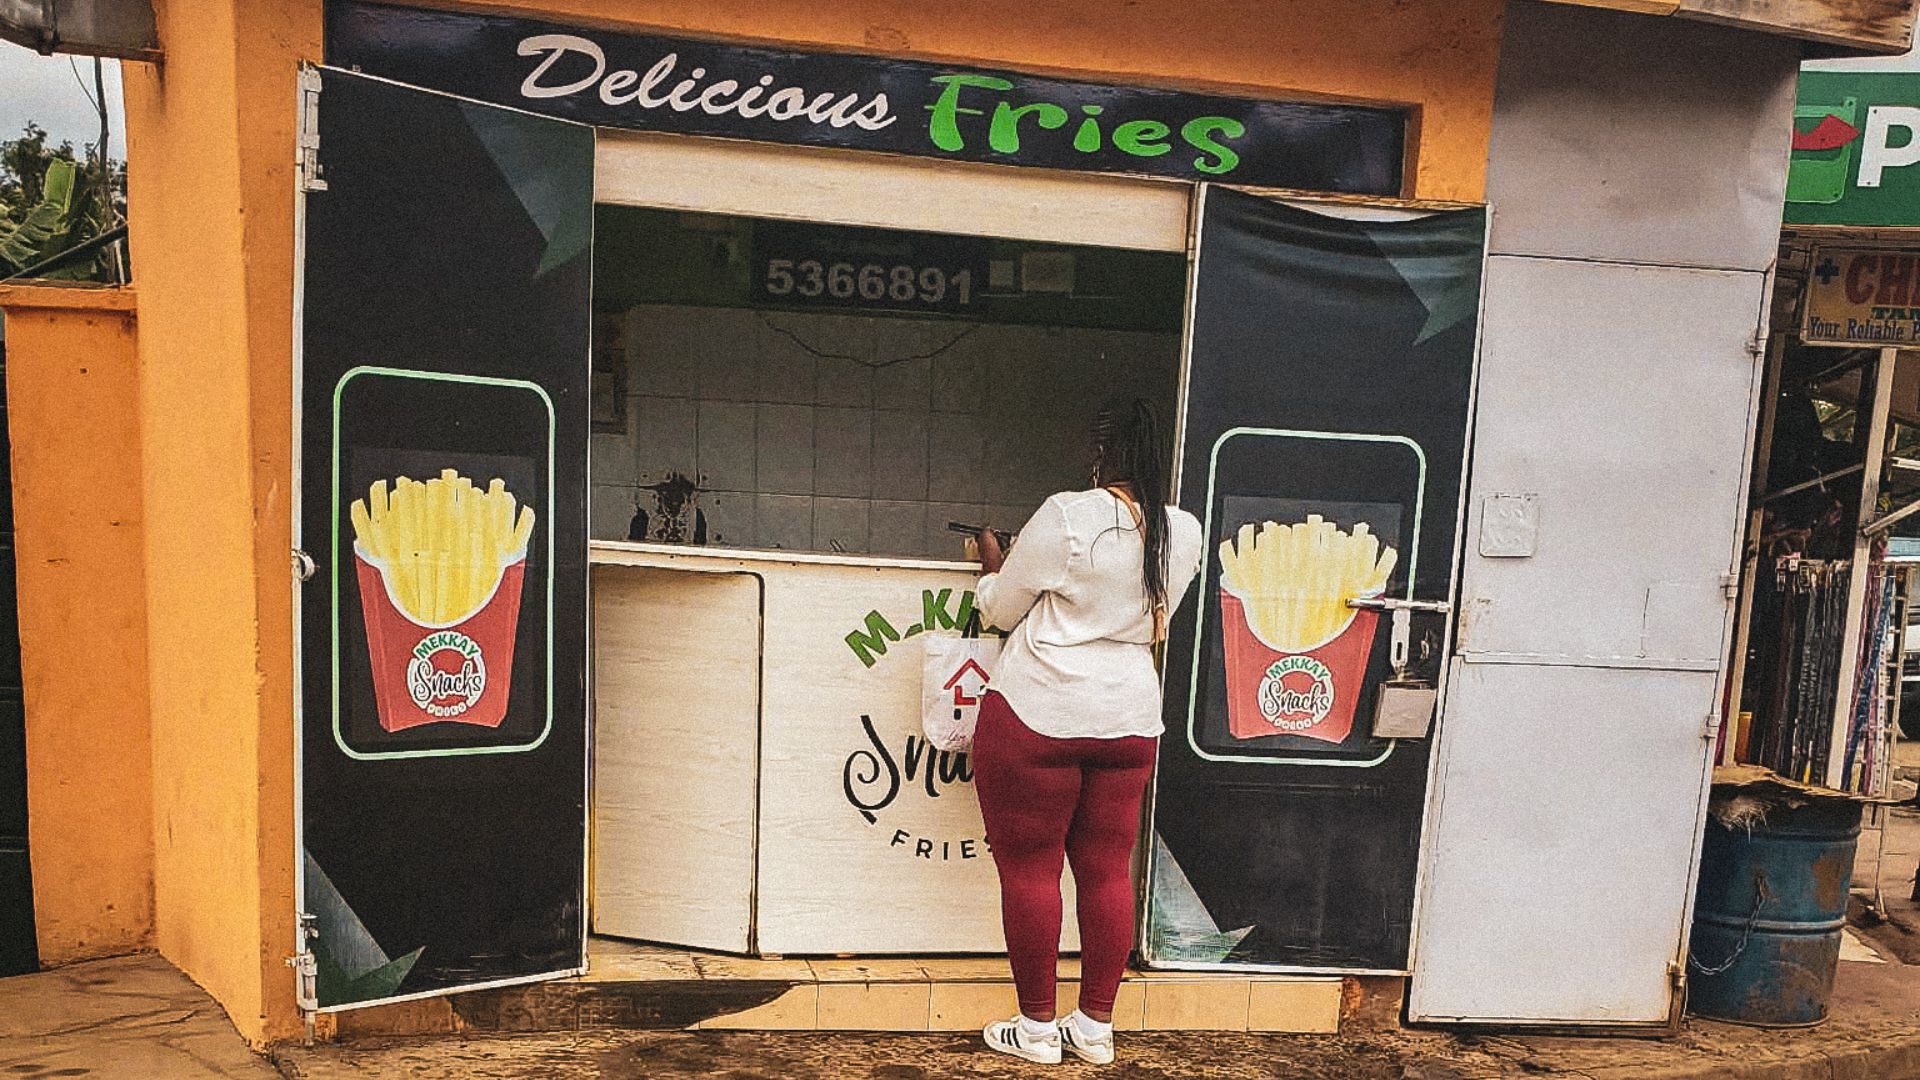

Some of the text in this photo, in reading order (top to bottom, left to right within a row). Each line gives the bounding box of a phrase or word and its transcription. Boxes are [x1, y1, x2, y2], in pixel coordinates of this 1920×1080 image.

[517, 33, 1246, 175] Delicious Fries
[766, 258, 971, 305] 5366891
[1845, 254, 1920, 306] CH
[1810, 315, 1840, 338] Your
[1847, 317, 1904, 340] Reliable
[415, 633, 479, 658] MEKKAY
[413, 660, 482, 702] Snacks
[1269, 658, 1329, 679] MEKKAY
[1263, 680, 1330, 717] Snacks
[890, 829, 992, 861] FRIE
